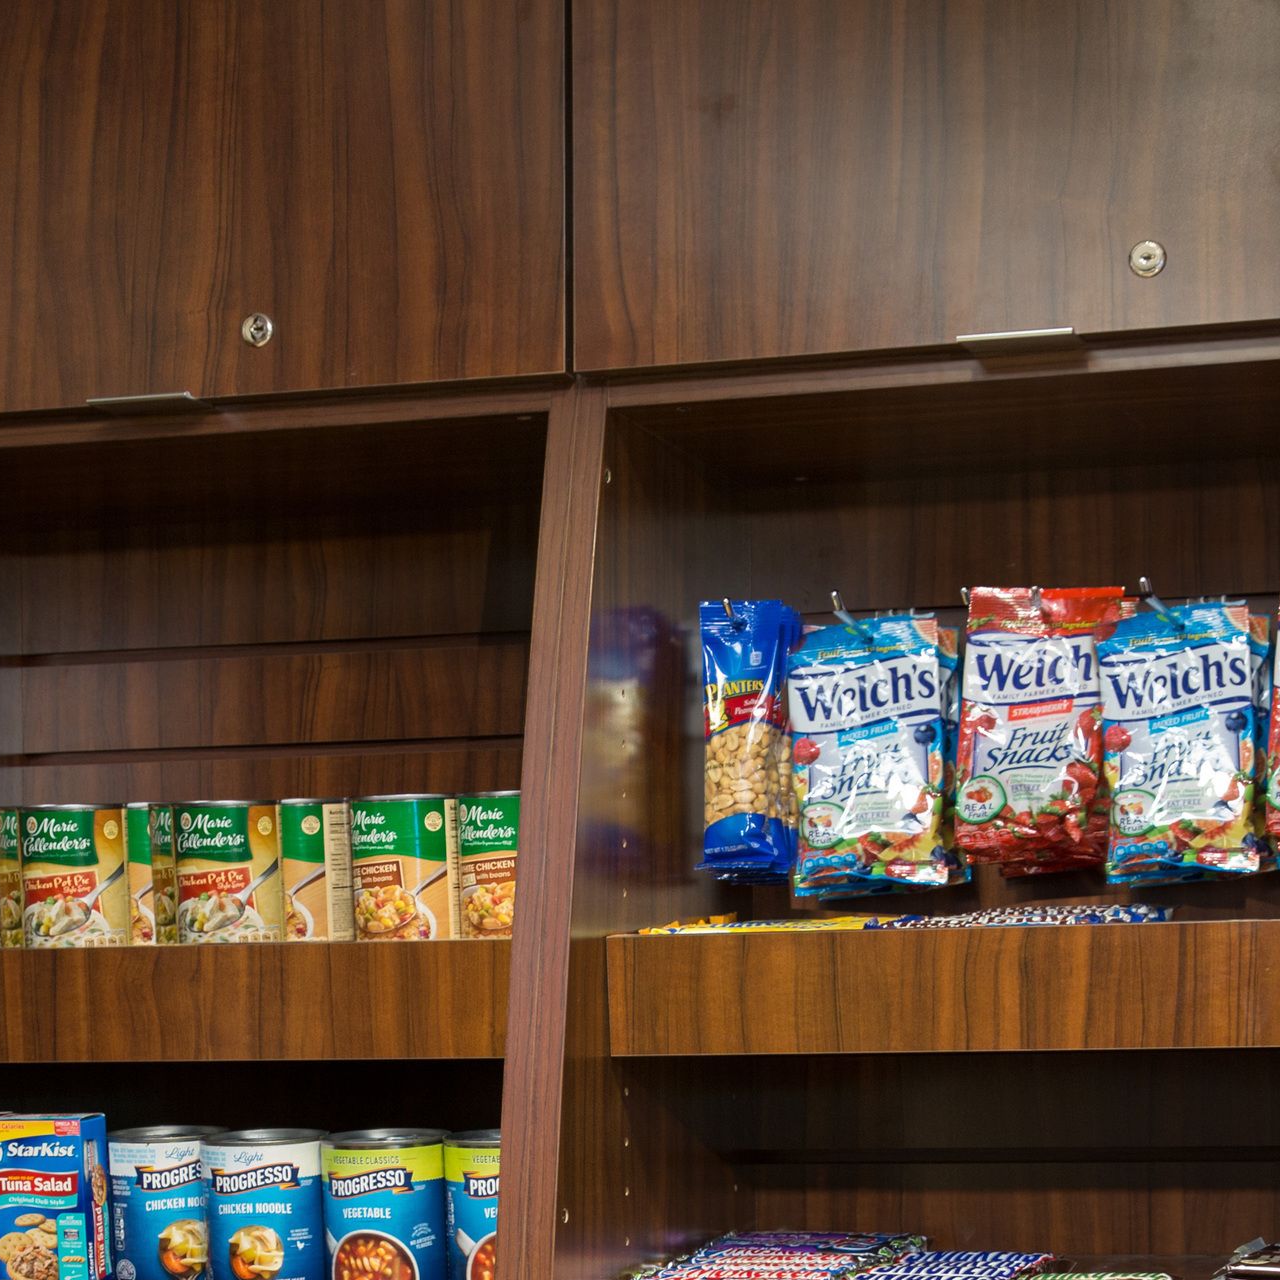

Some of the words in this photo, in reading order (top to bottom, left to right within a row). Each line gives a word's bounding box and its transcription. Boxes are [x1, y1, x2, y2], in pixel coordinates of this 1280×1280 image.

[1108, 654, 1246, 709] Welch's
[795, 665, 935, 722] Welch's
[993, 692, 1022, 700] FAMILY
[1024, 689, 1055, 698] FARMER
[1192, 691, 1224, 702] OWNED
[883, 704, 912, 715] OWNED
[1152, 714, 1178, 729] MIXED
[841, 730, 869, 741] MIXED
[870, 725, 896, 734] FRUIT
[1009, 724, 1070, 750] Fruit
[987, 742, 1073, 772] Snacks
[963, 802, 996, 814] REAL
[36, 817, 79, 839] Marie
[191, 814, 233, 838] Marie
[23, 836, 90, 859] Callender's
[53, 876, 73, 889] Pot
[207, 874, 226, 888] Pot
[361, 874, 376, 883] with
[376, 874, 394, 882] beans
[476, 872, 490, 881] with
[490, 871, 511, 880] beans
[7, 1142, 76, 1157] StarKist
[165, 1147, 195, 1160] Light
[233, 1151, 264, 1166] Light
[333, 1155, 364, 1165] VEGETABLE
[366, 1155, 399, 1164] CLASSICS
[0, 1177, 31, 1192] Tuna
[33, 1177, 72, 1192] Salad
[216, 1166, 292, 1193] PROGRESSO
[332, 1170, 405, 1196] PROGRESSO
[256, 1202, 292, 1214] NOODLE
[343, 1207, 391, 1218] VEGETABLE
